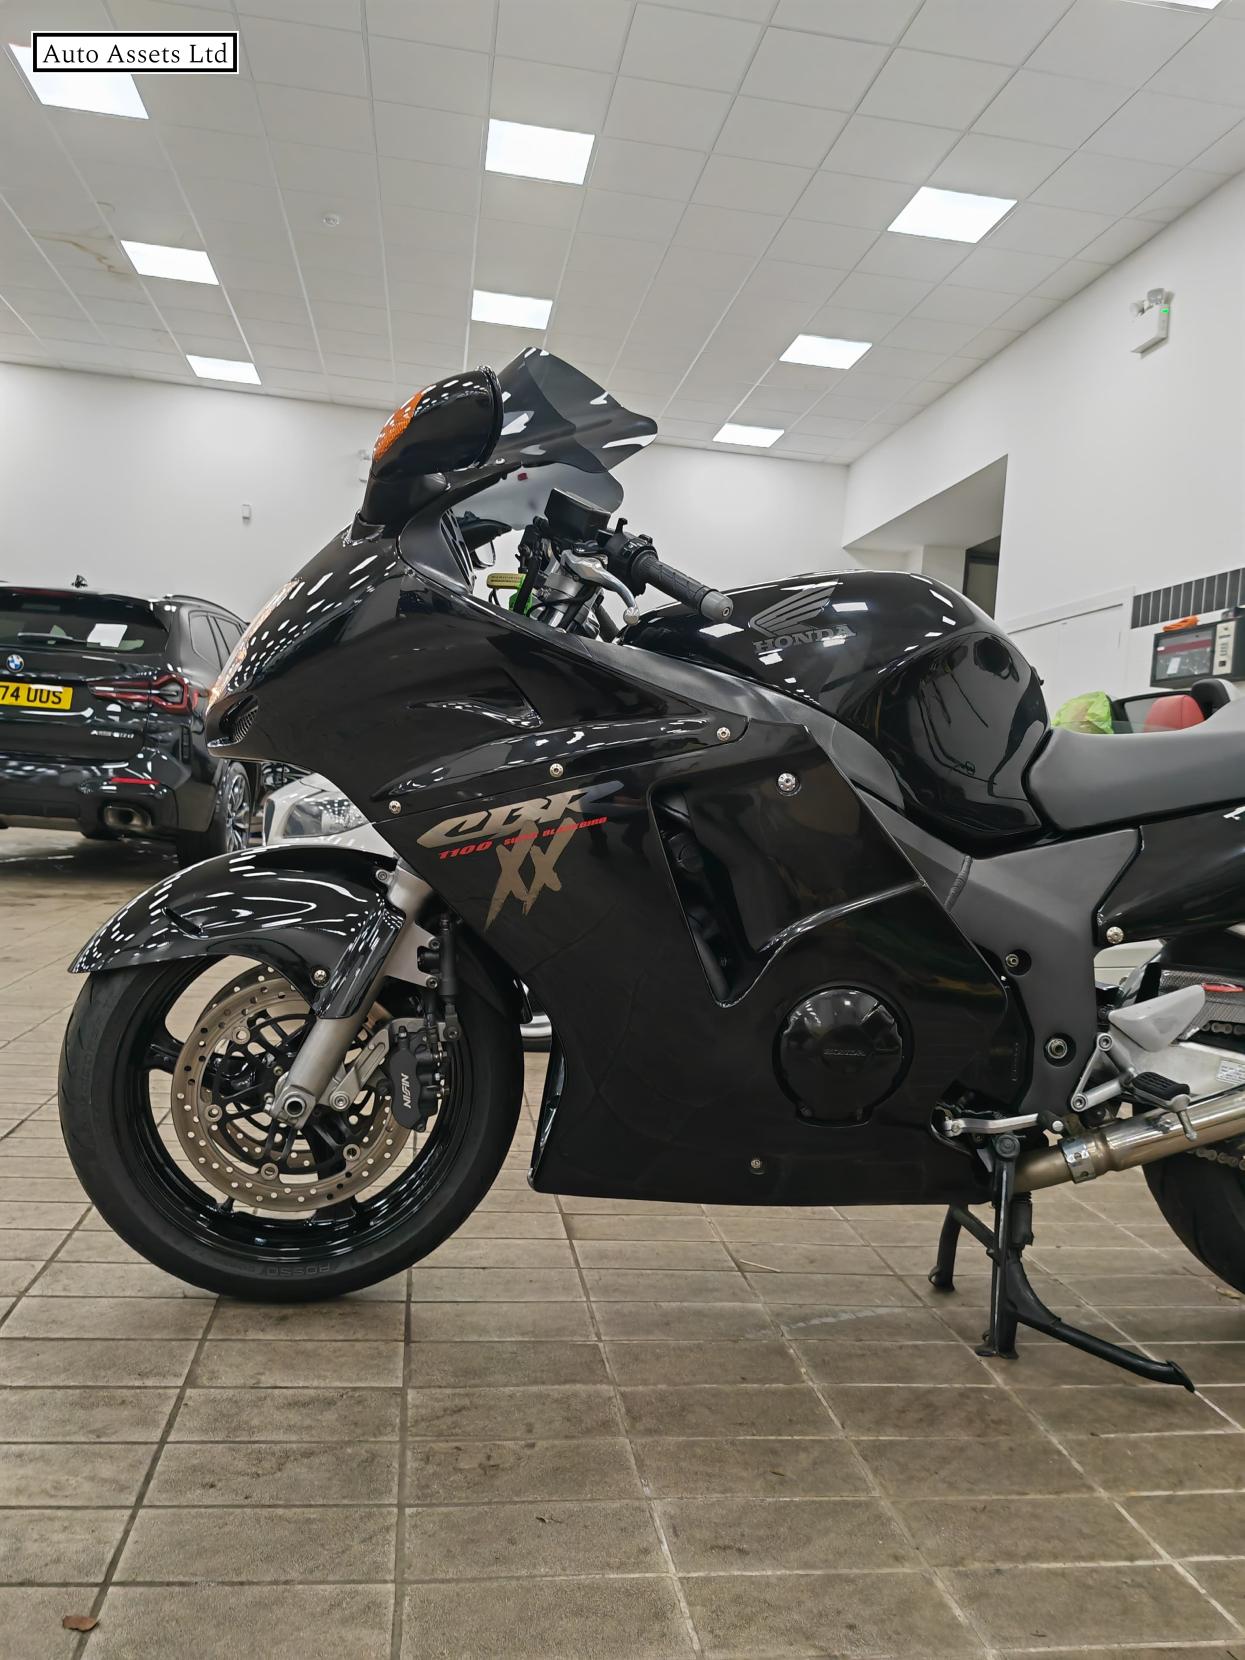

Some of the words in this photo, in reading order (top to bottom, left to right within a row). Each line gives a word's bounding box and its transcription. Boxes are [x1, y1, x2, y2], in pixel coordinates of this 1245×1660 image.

[752, 624, 857, 654] HONDA
[416, 780, 625, 849] CBR
[438, 840, 494, 860] 1100
[484, 817, 577, 932] XX
[400, 1072, 412, 1109] NISSIN
